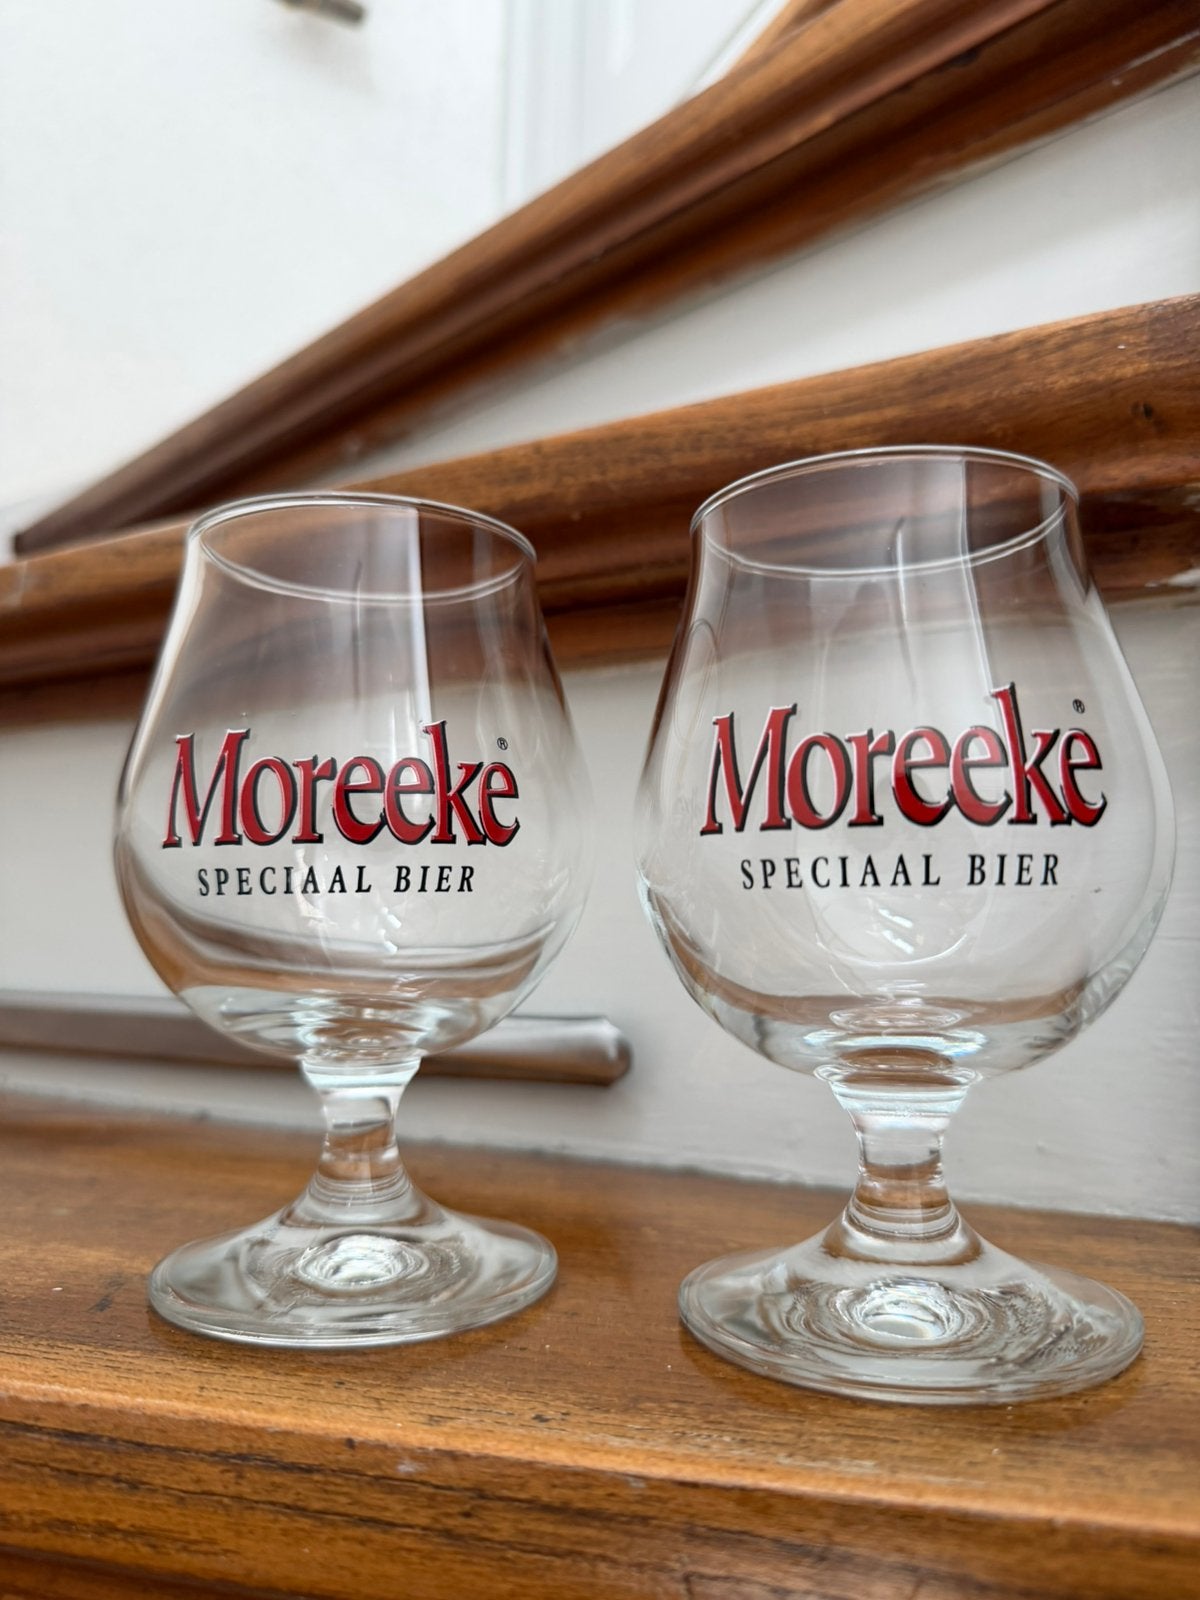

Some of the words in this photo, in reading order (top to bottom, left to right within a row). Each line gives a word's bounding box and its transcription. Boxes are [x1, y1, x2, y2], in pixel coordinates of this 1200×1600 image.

[162, 720, 521, 849] Moreeke
[700, 682, 1108, 836] Moreeke
[197, 865, 373, 896] SPECIAAL
[393, 864, 476, 893] BIER
[740, 854, 941, 890] SPECIAAL
[966, 854, 1060, 887] BIER
